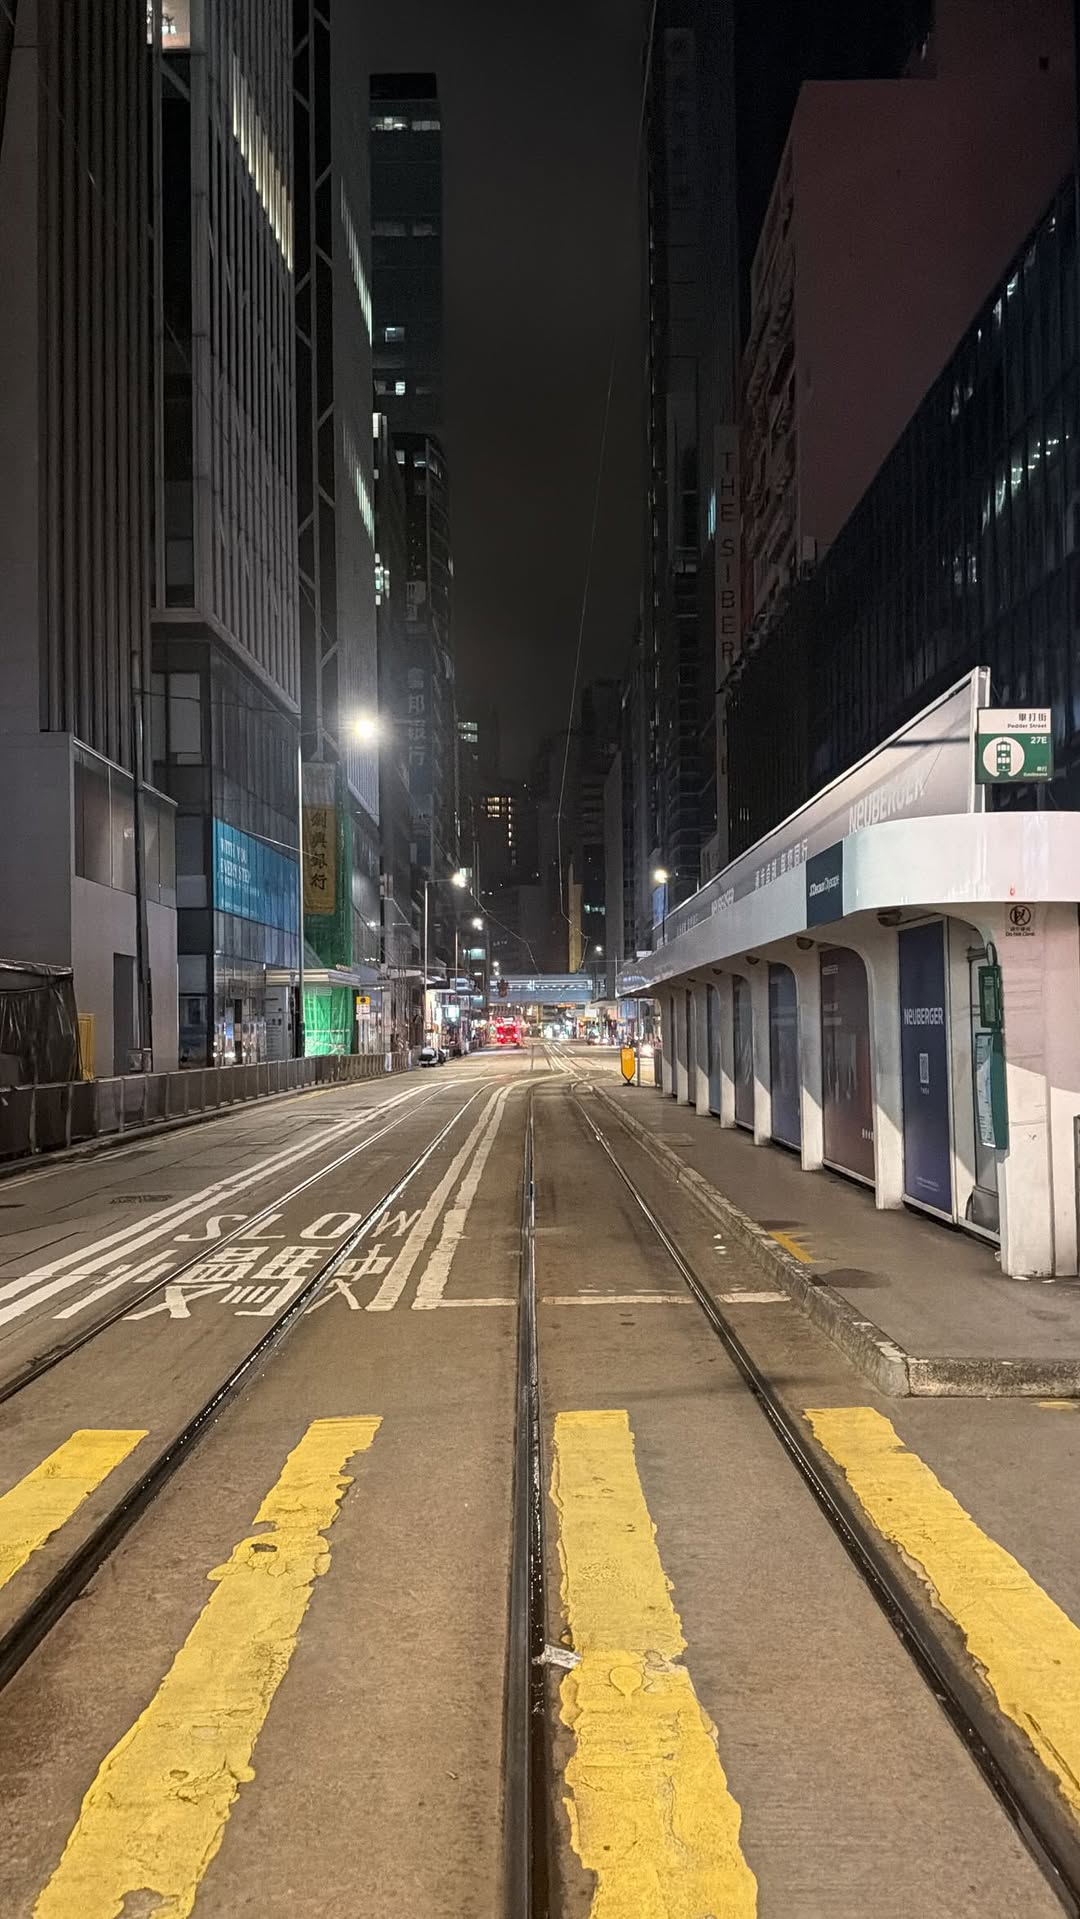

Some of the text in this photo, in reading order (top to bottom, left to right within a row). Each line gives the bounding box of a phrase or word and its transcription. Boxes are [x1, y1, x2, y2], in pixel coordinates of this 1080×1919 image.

[719, 452, 736, 523] THE
[1030, 736, 1048, 744] 27E
[309, 810, 328, 891] 創興銀行
[173, 1209, 422, 1242] SLOW
